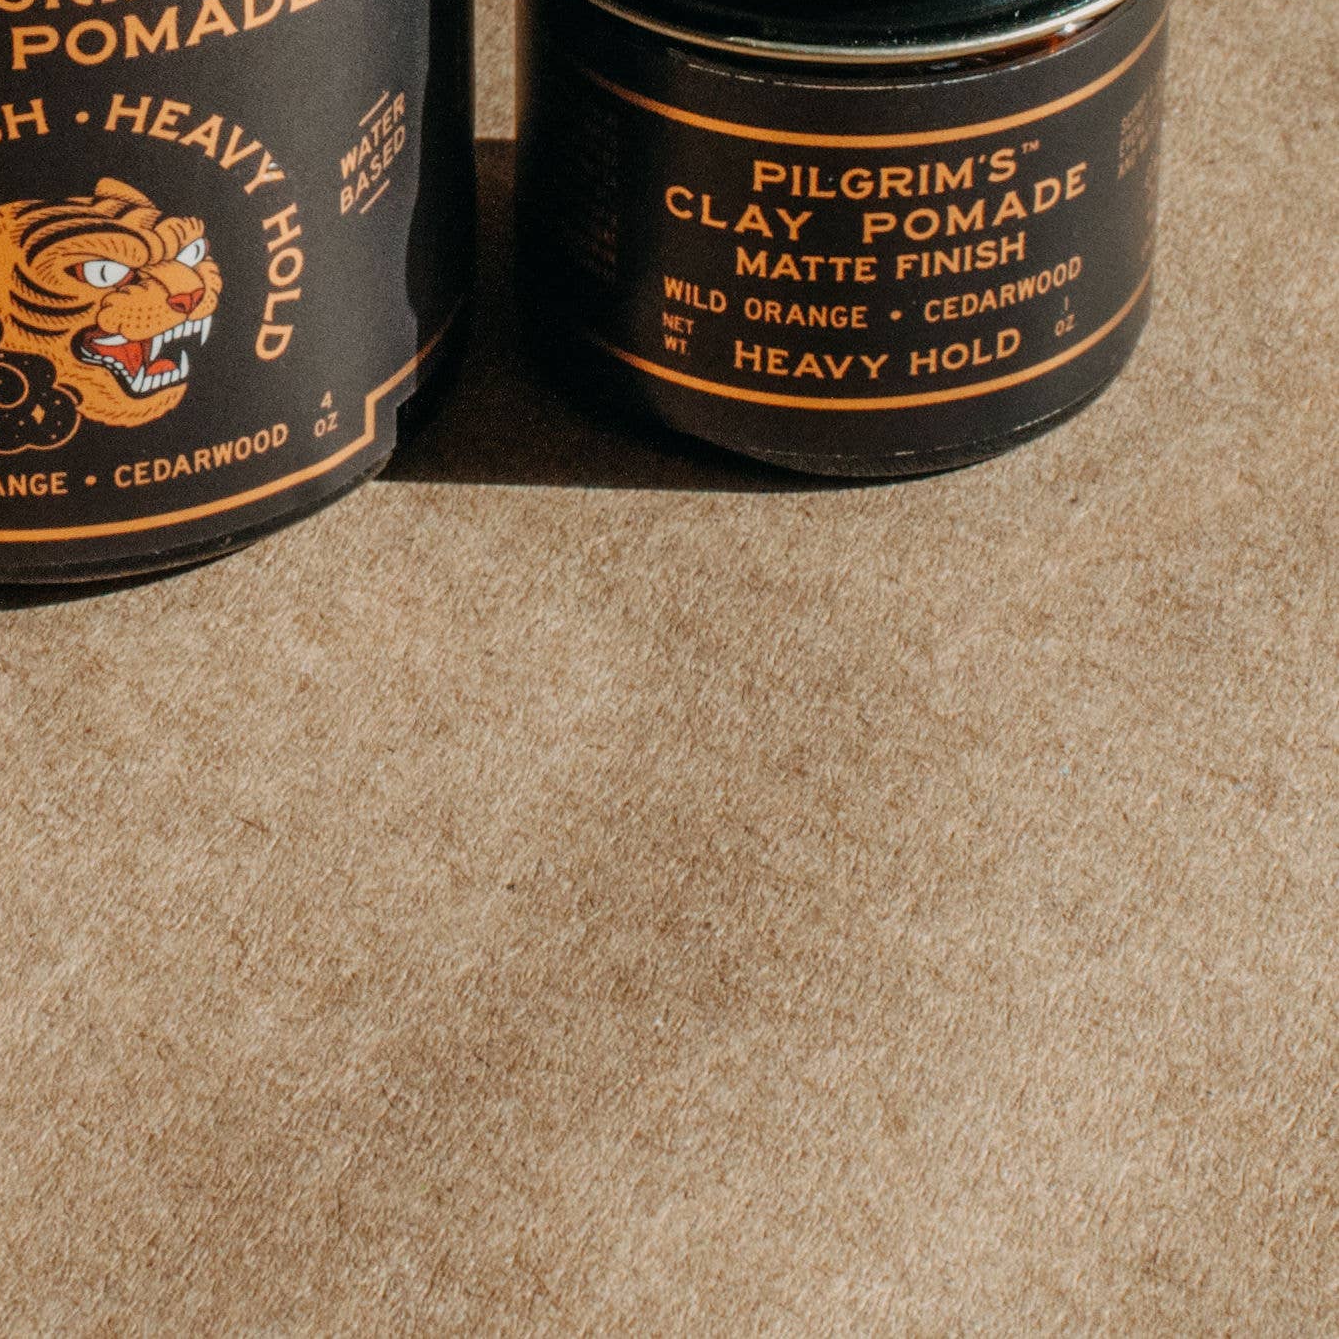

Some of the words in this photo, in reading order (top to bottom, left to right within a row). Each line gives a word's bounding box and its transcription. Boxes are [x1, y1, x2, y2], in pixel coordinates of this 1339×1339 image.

[340, 91, 405, 180] WATER
[340, 125, 405, 215] BASED
[104, 94, 285, 195] HEAVY
[255, 202, 305, 361] HOLD
[665, 185, 813, 241] CLAY
[862, 161, 1088, 244] POMADE
[663, 276, 728, 314] WILD
[744, 297, 868, 329] ORANGE
[924, 254, 1083, 323] CEDARWOOD
[735, 246, 878, 284] MATTE
[896, 230, 1026, 280] FINISH
[662, 311, 694, 335] NET
[734, 339, 889, 380] HEAVY
[910, 327, 1022, 376] HOLD
[320, 390, 333, 409] 4
[114, 422, 290, 488] CEDARWOOD
